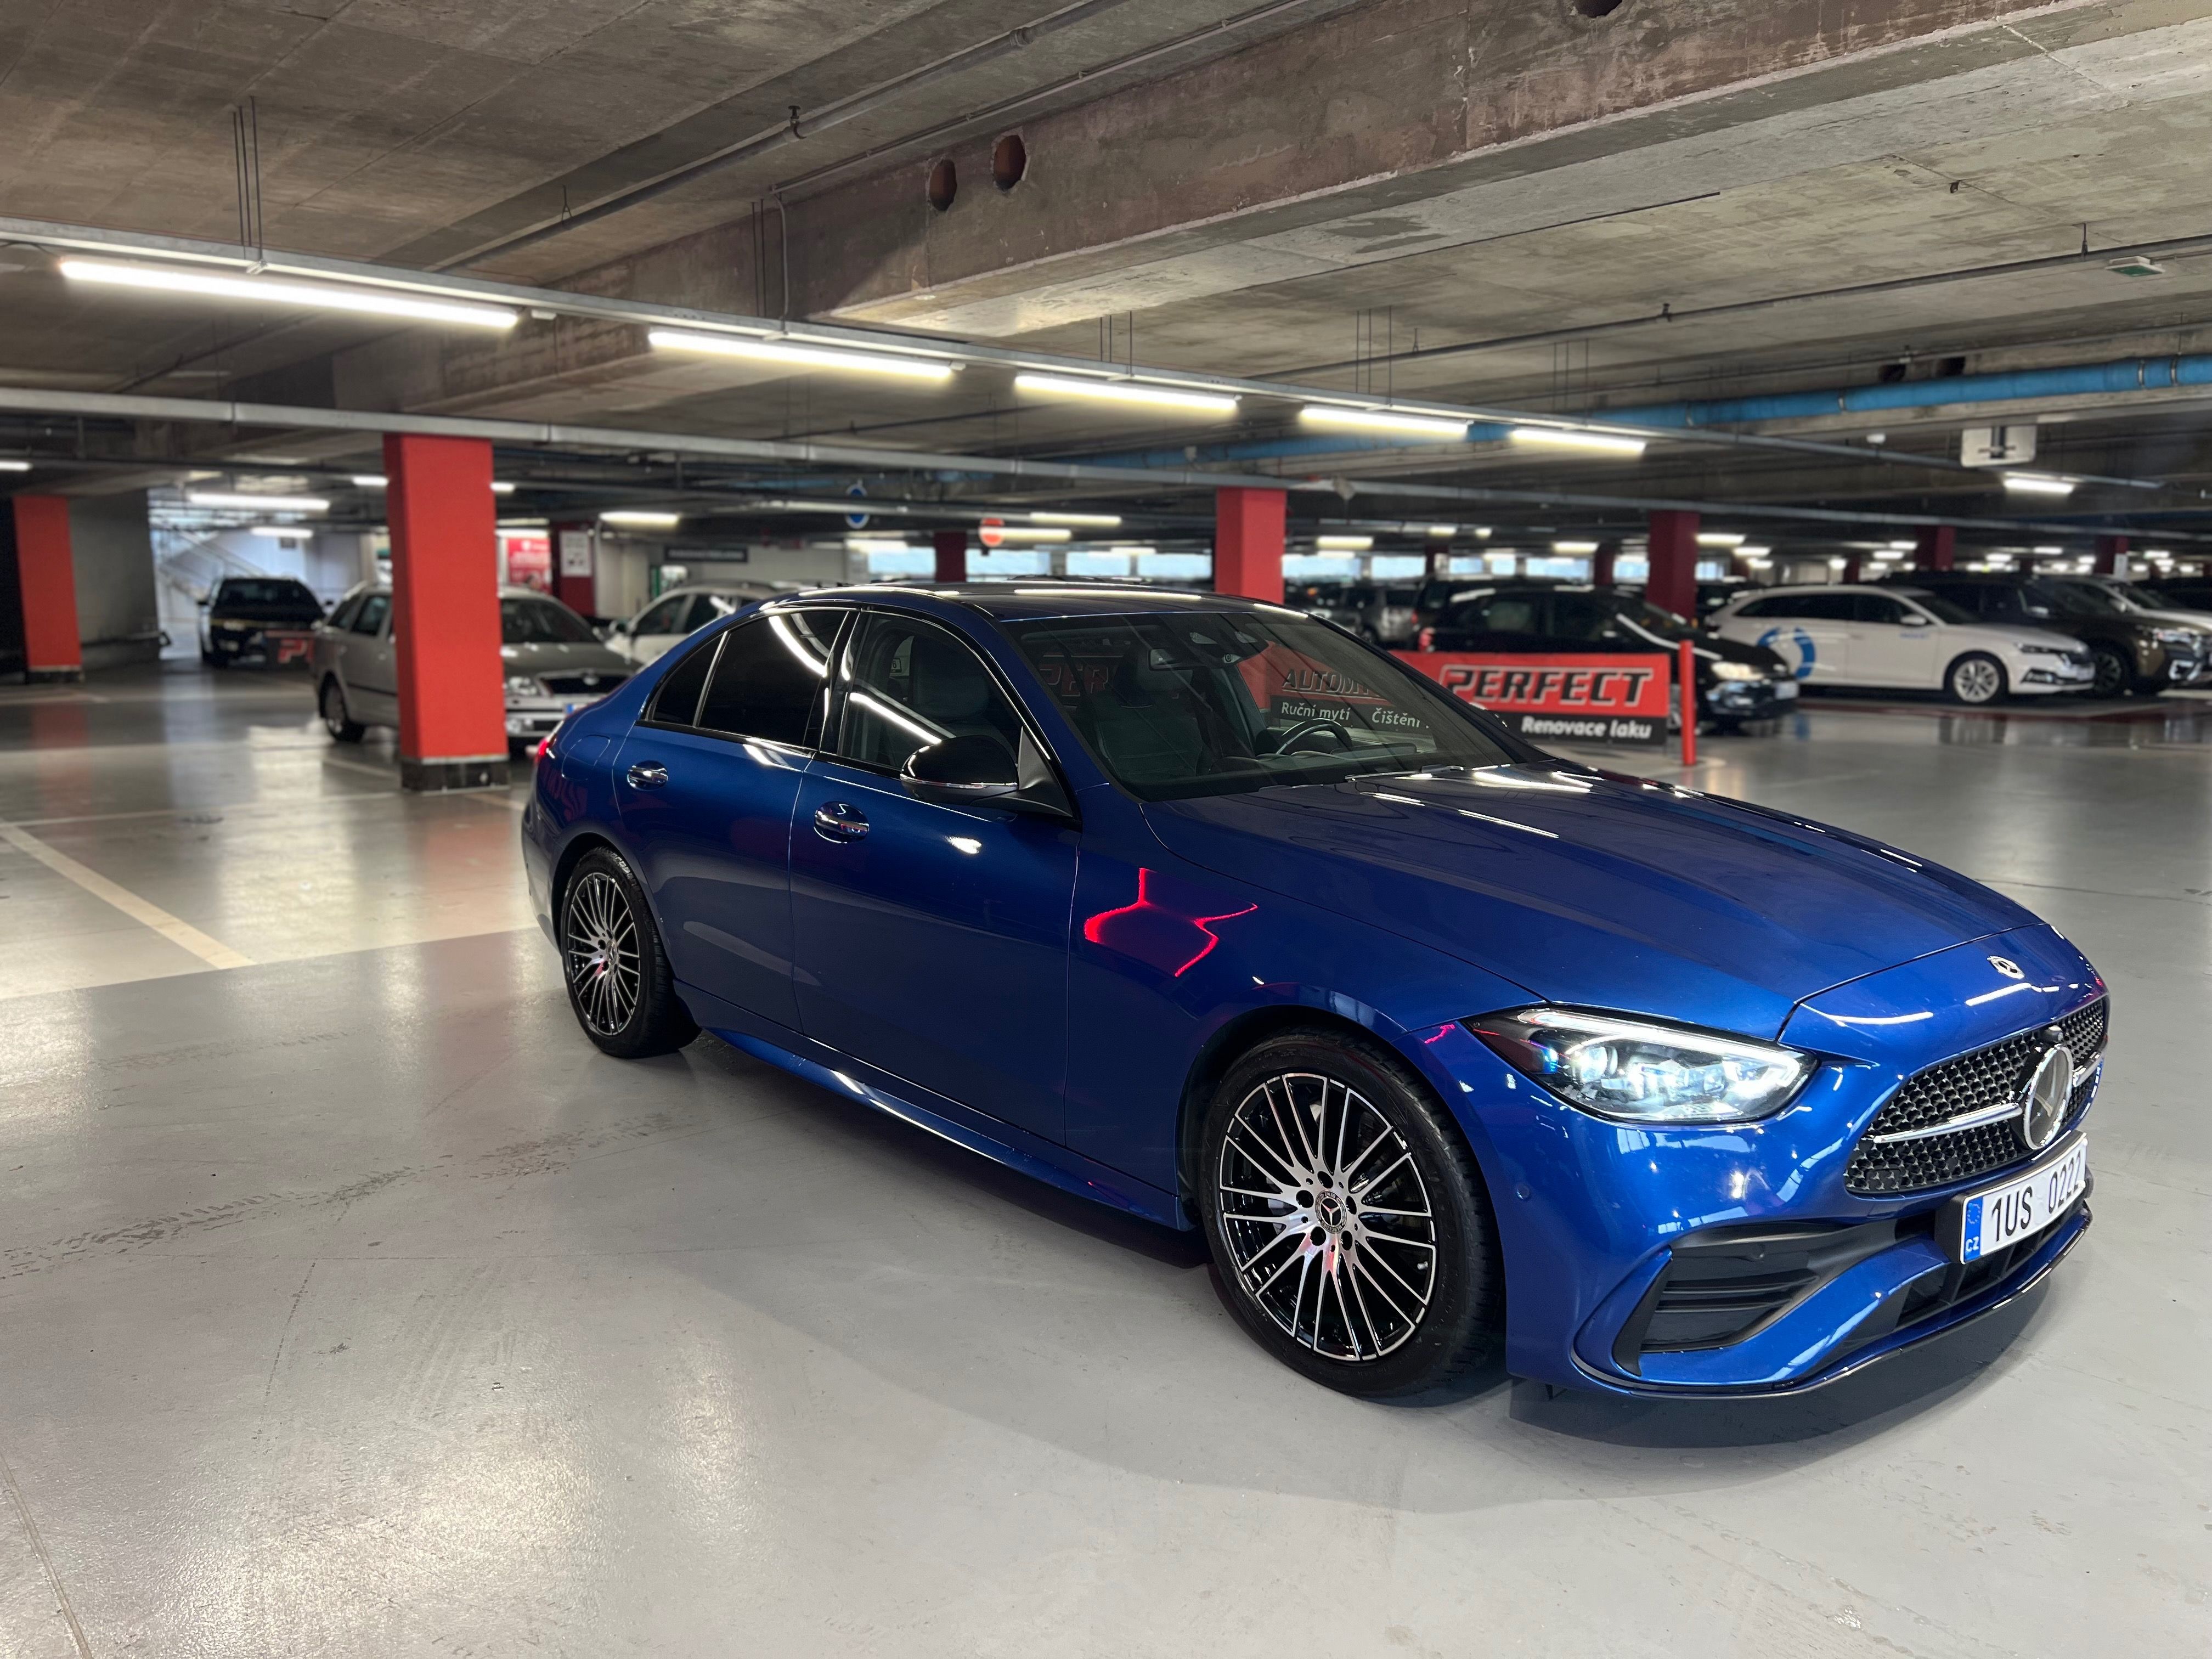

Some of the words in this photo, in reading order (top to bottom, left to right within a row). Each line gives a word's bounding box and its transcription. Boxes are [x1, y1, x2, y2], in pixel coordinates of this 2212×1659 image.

[1440, 664, 1654, 708] PERFECT
[1282, 702, 1316, 717] Ruční
[1319, 707, 1351, 721] mytí
[1521, 715, 1606, 737] Renovace
[1610, 720, 1652, 738] laku
[1991, 1186, 2033, 1242] 1US
[1965, 1237, 1979, 1253] CZ
